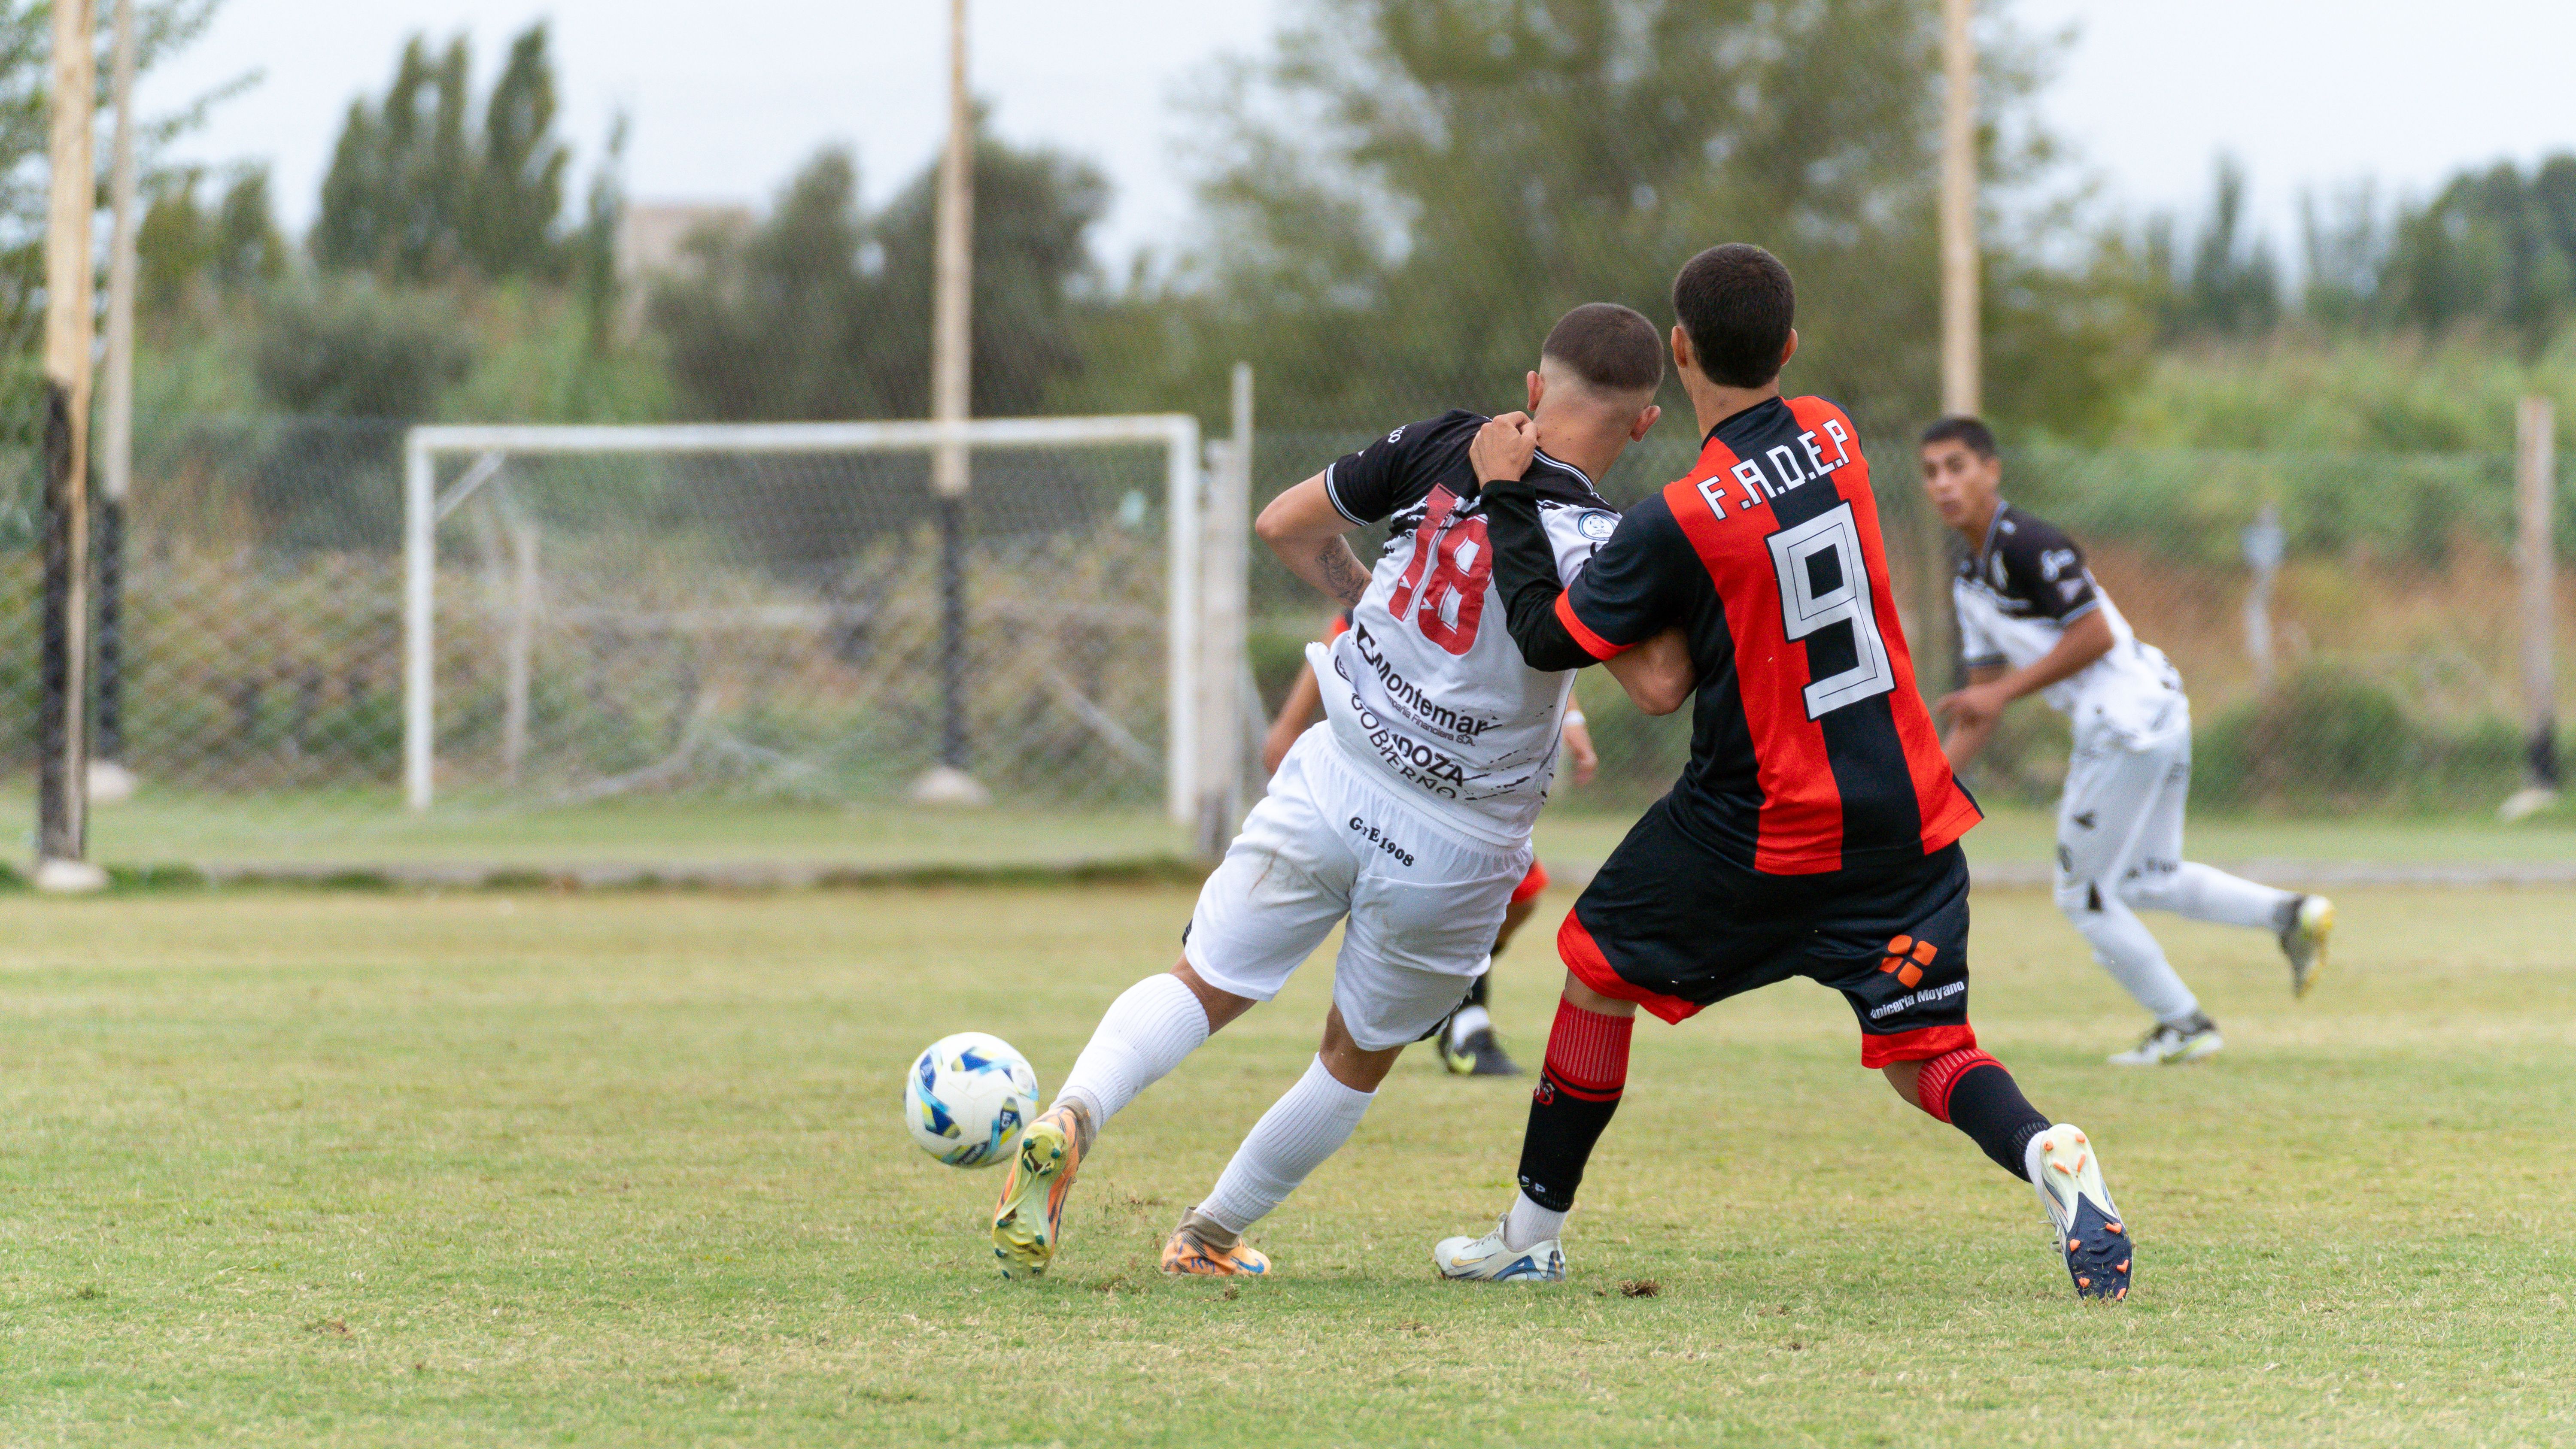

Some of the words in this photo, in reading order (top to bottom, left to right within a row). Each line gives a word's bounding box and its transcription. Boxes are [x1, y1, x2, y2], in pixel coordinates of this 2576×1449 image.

[1697, 418, 1850, 521] F.A.D.E.P
[1388, 482, 1494, 656] 18
[1764, 498, 1896, 722] 9
[1373, 652, 1489, 736] Montemar
[1917, 981, 1965, 1003] Moyano
